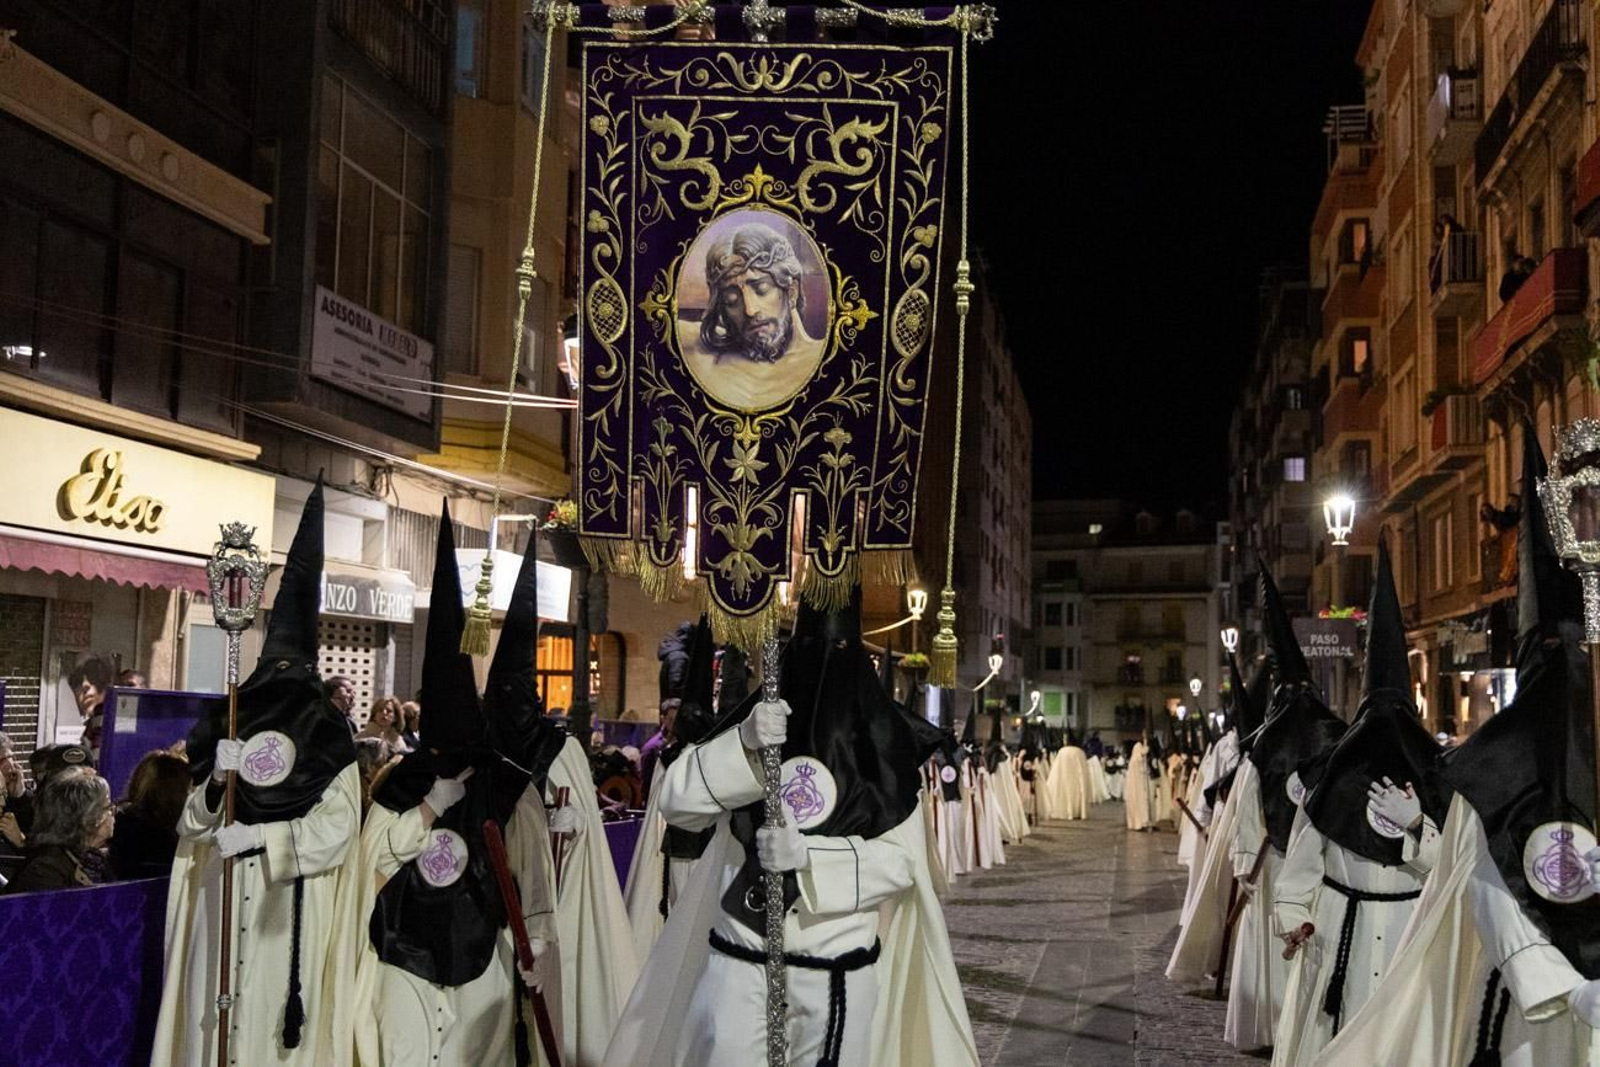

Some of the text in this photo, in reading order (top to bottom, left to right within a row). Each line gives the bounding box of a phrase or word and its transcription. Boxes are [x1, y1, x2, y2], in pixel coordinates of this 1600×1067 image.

[321, 297, 374, 335] ASESORIA
[56, 448, 168, 533] Elisa
[369, 588, 413, 618] VERDE
[1310, 634, 1339, 644] PASO
